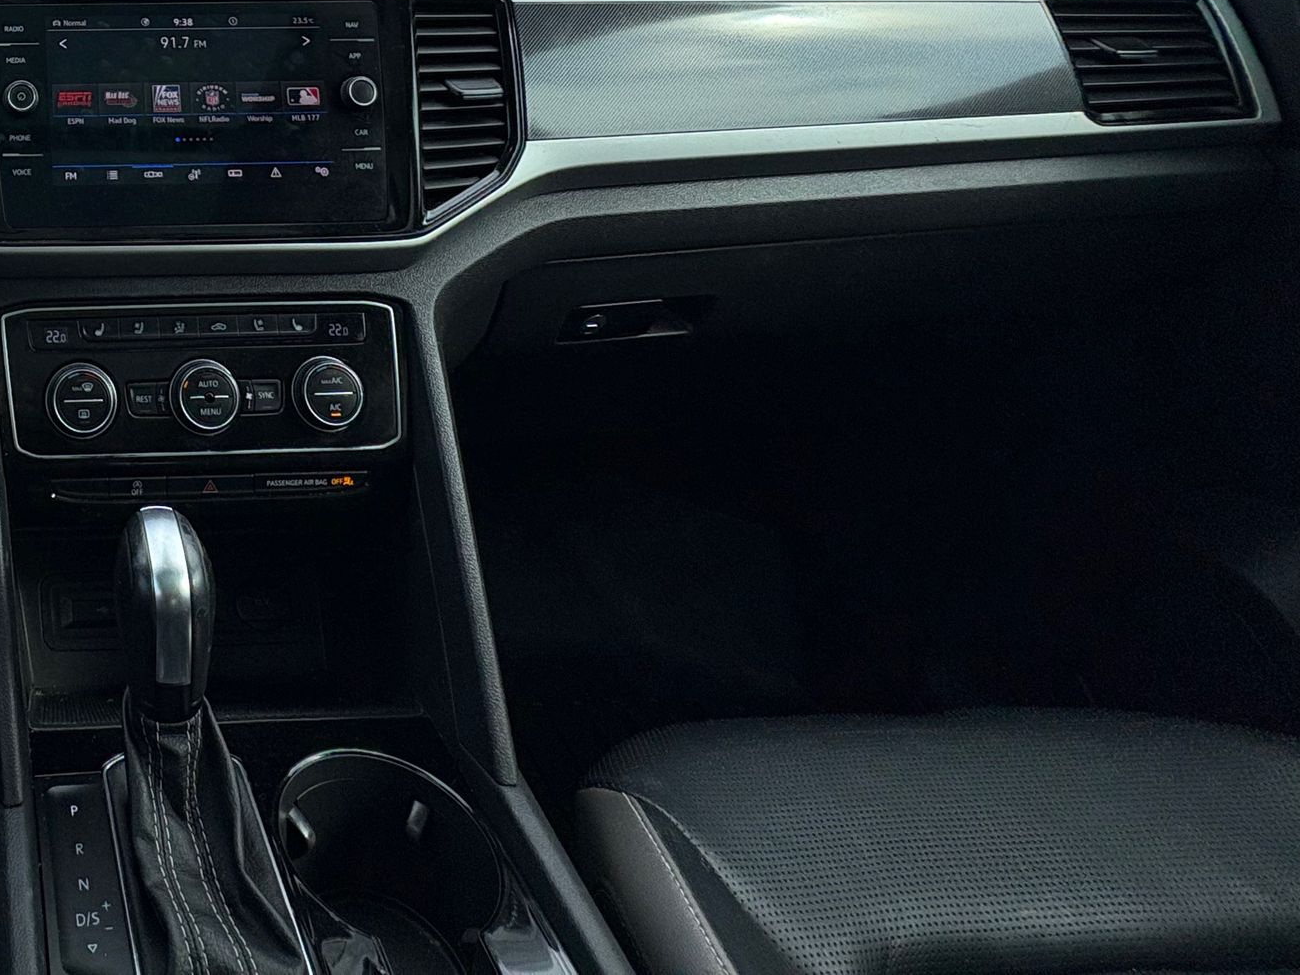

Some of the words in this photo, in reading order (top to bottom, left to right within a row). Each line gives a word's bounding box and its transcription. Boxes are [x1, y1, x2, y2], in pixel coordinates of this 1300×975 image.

[63, 19, 87, 27] Normal
[173, 18, 194, 27] 9:38
[345, 21, 359, 29] NAV
[4, 25, 25, 33] RADIO
[160, 36, 190, 49] 91.7
[193, 40, 208, 49] FM
[348, 52, 362, 60] APP
[161, 91, 179, 99] FOX
[157, 98, 180, 106] NEWS
[67, 117, 85, 125] ESPN
[108, 117, 122, 125] Mad
[123, 117, 137, 126] Dog
[152, 116, 167, 124] FOX
[167, 116, 185, 124] News
[246, 114, 274, 124] Worship
[291, 114, 306, 122] MLB
[307, 113, 320, 121] 177
[353, 128, 369, 136] CAR
[8, 134, 32, 142] PHONE
[354, 162, 374, 170] MENU
[11, 168, 32, 176] VOICE
[65, 172, 78, 181] FM
[198, 380, 219, 388] AUTO
[135, 394, 152, 403] REST
[257, 391, 275, 400] SYNC
[329, 403, 342, 412] A/C
[200, 408, 222, 416] MENU
[266, 479, 303, 487] PASSENGER
[314, 478, 328, 486] BAG
[331, 478, 343, 486] OFF
[131, 488, 143, 496] OFF
[70, 804, 79, 817] P
[75, 843, 85, 855] R
[78, 877, 90, 892] N
[75, 911, 101, 927] D/S
